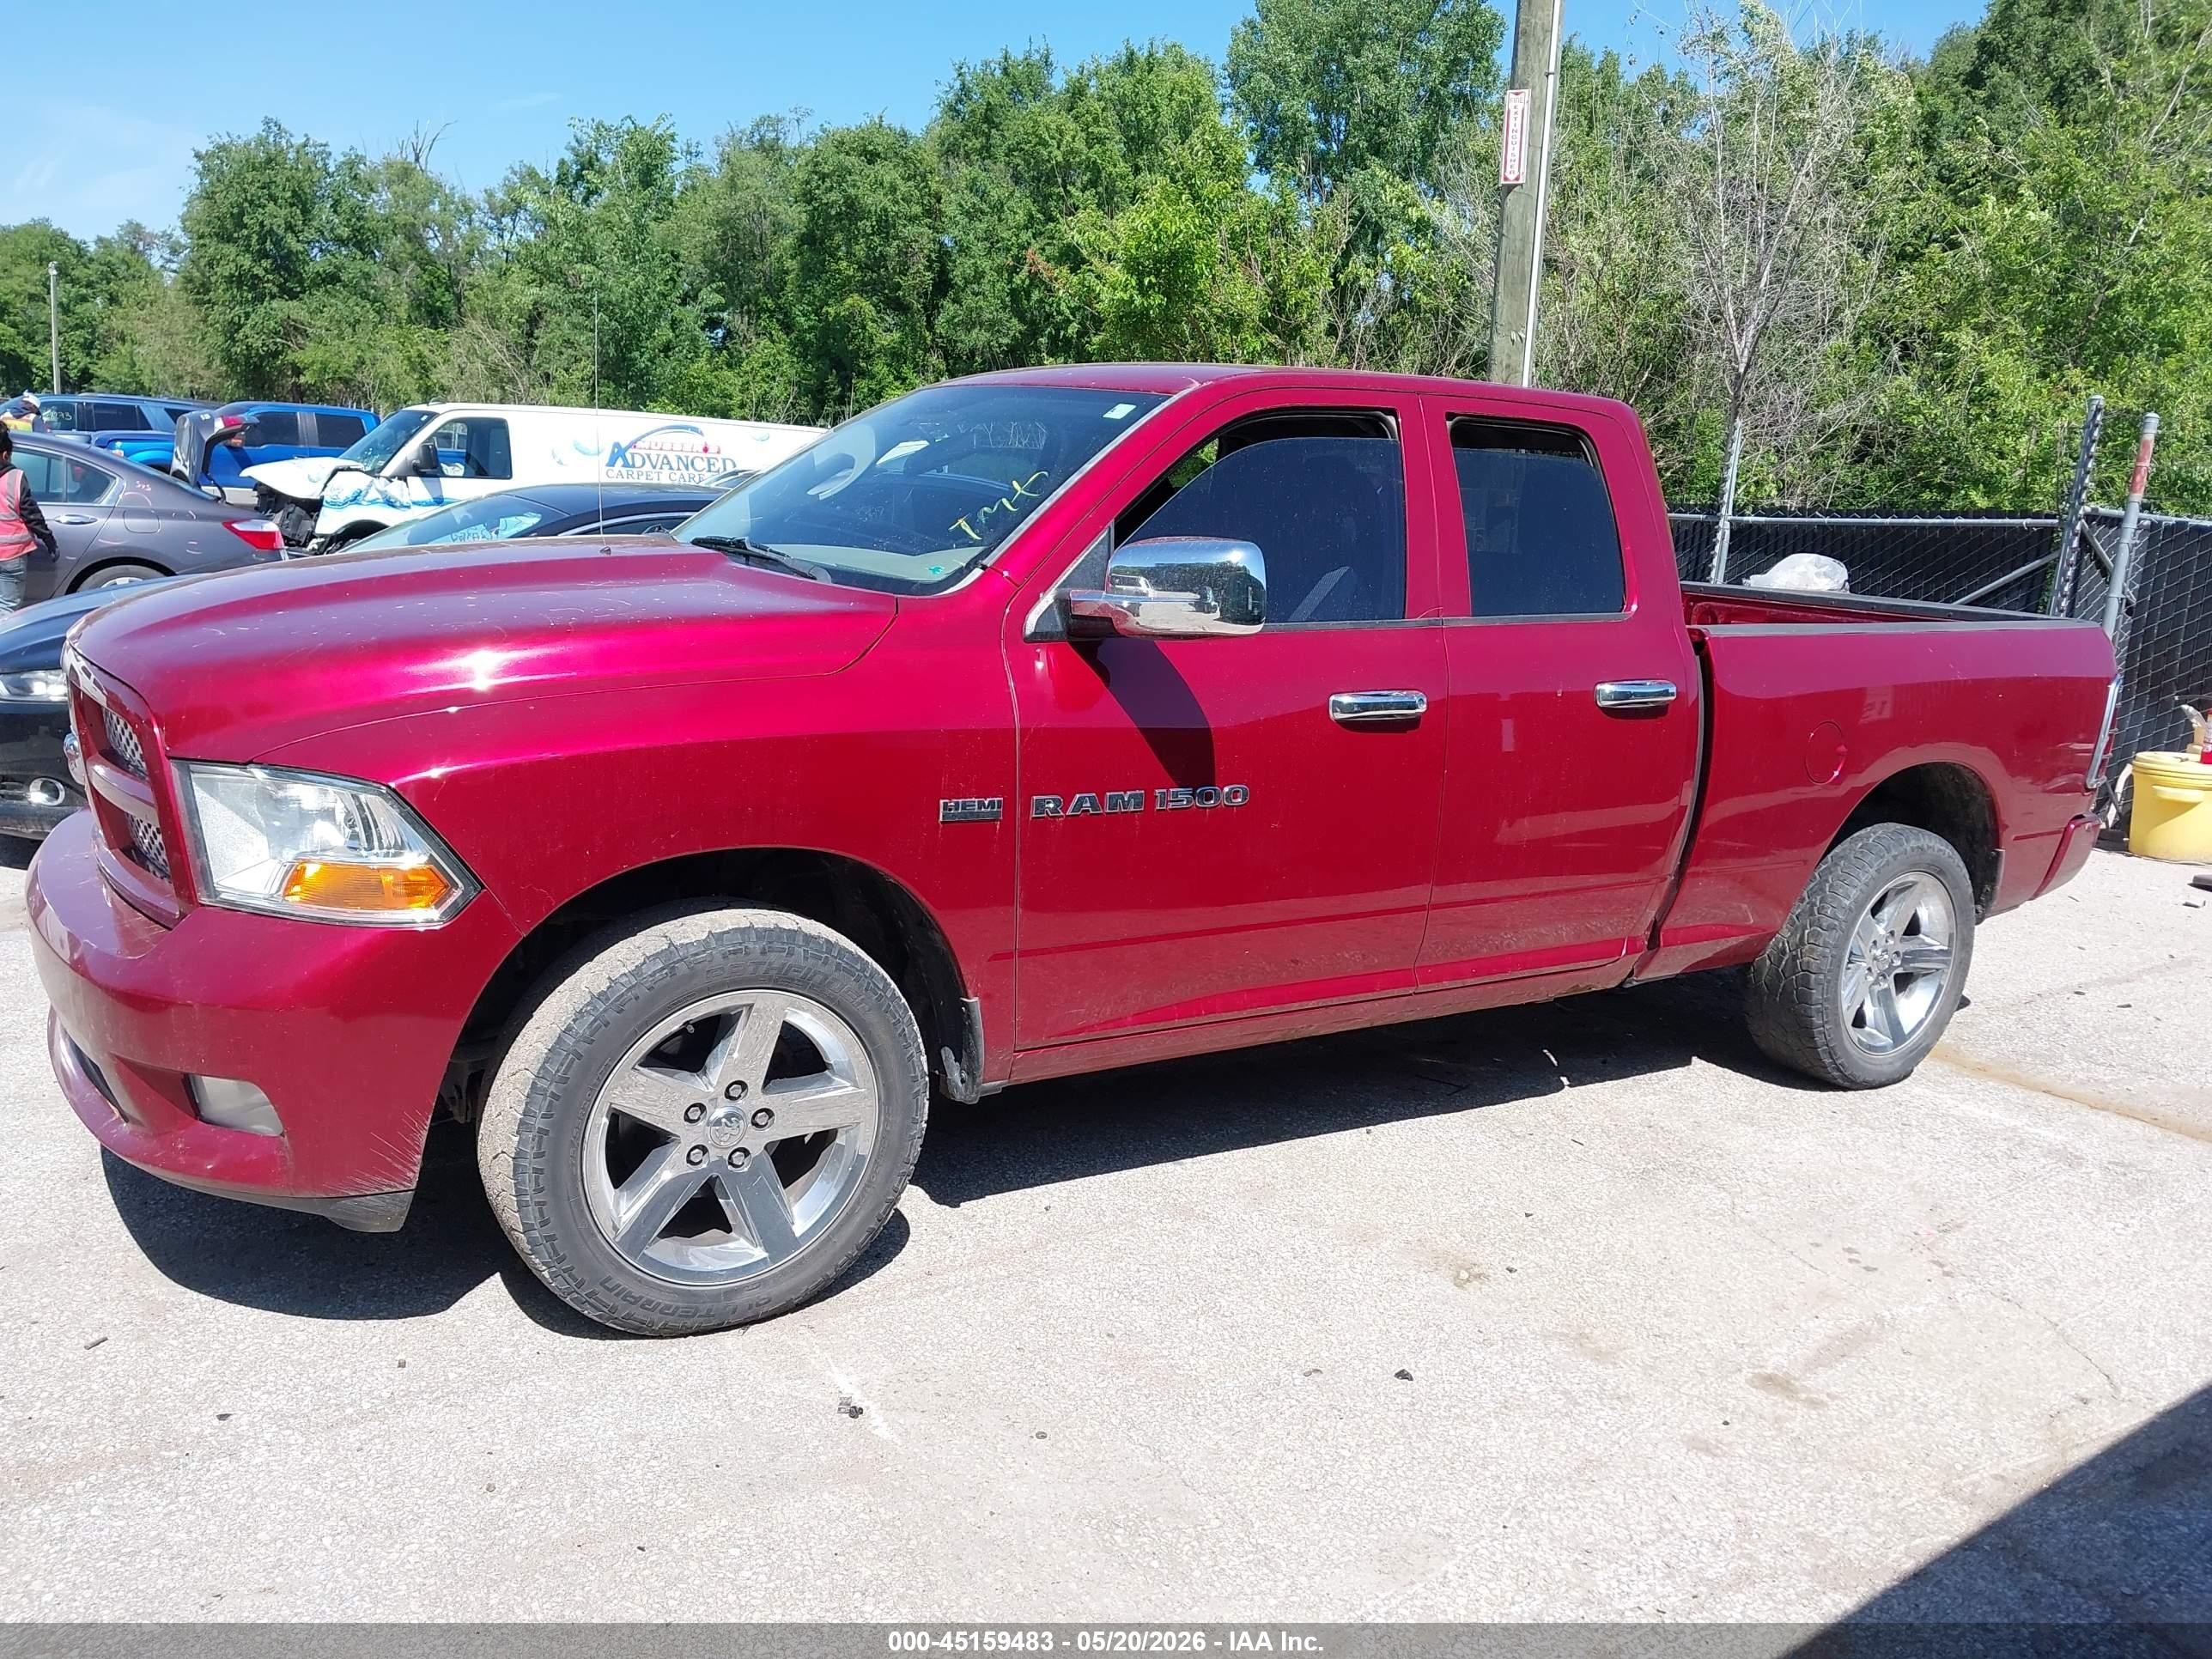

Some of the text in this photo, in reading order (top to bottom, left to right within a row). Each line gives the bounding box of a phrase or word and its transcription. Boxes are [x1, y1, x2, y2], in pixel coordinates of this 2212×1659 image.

[1510, 104, 1519, 174] EXTINGUISHER
[605, 441, 738, 473] ADVANCED
[605, 468, 705, 483] CARPET CARE
[939, 798, 1003, 815] HEMI
[1030, 784, 1249, 817] RAM 1500
